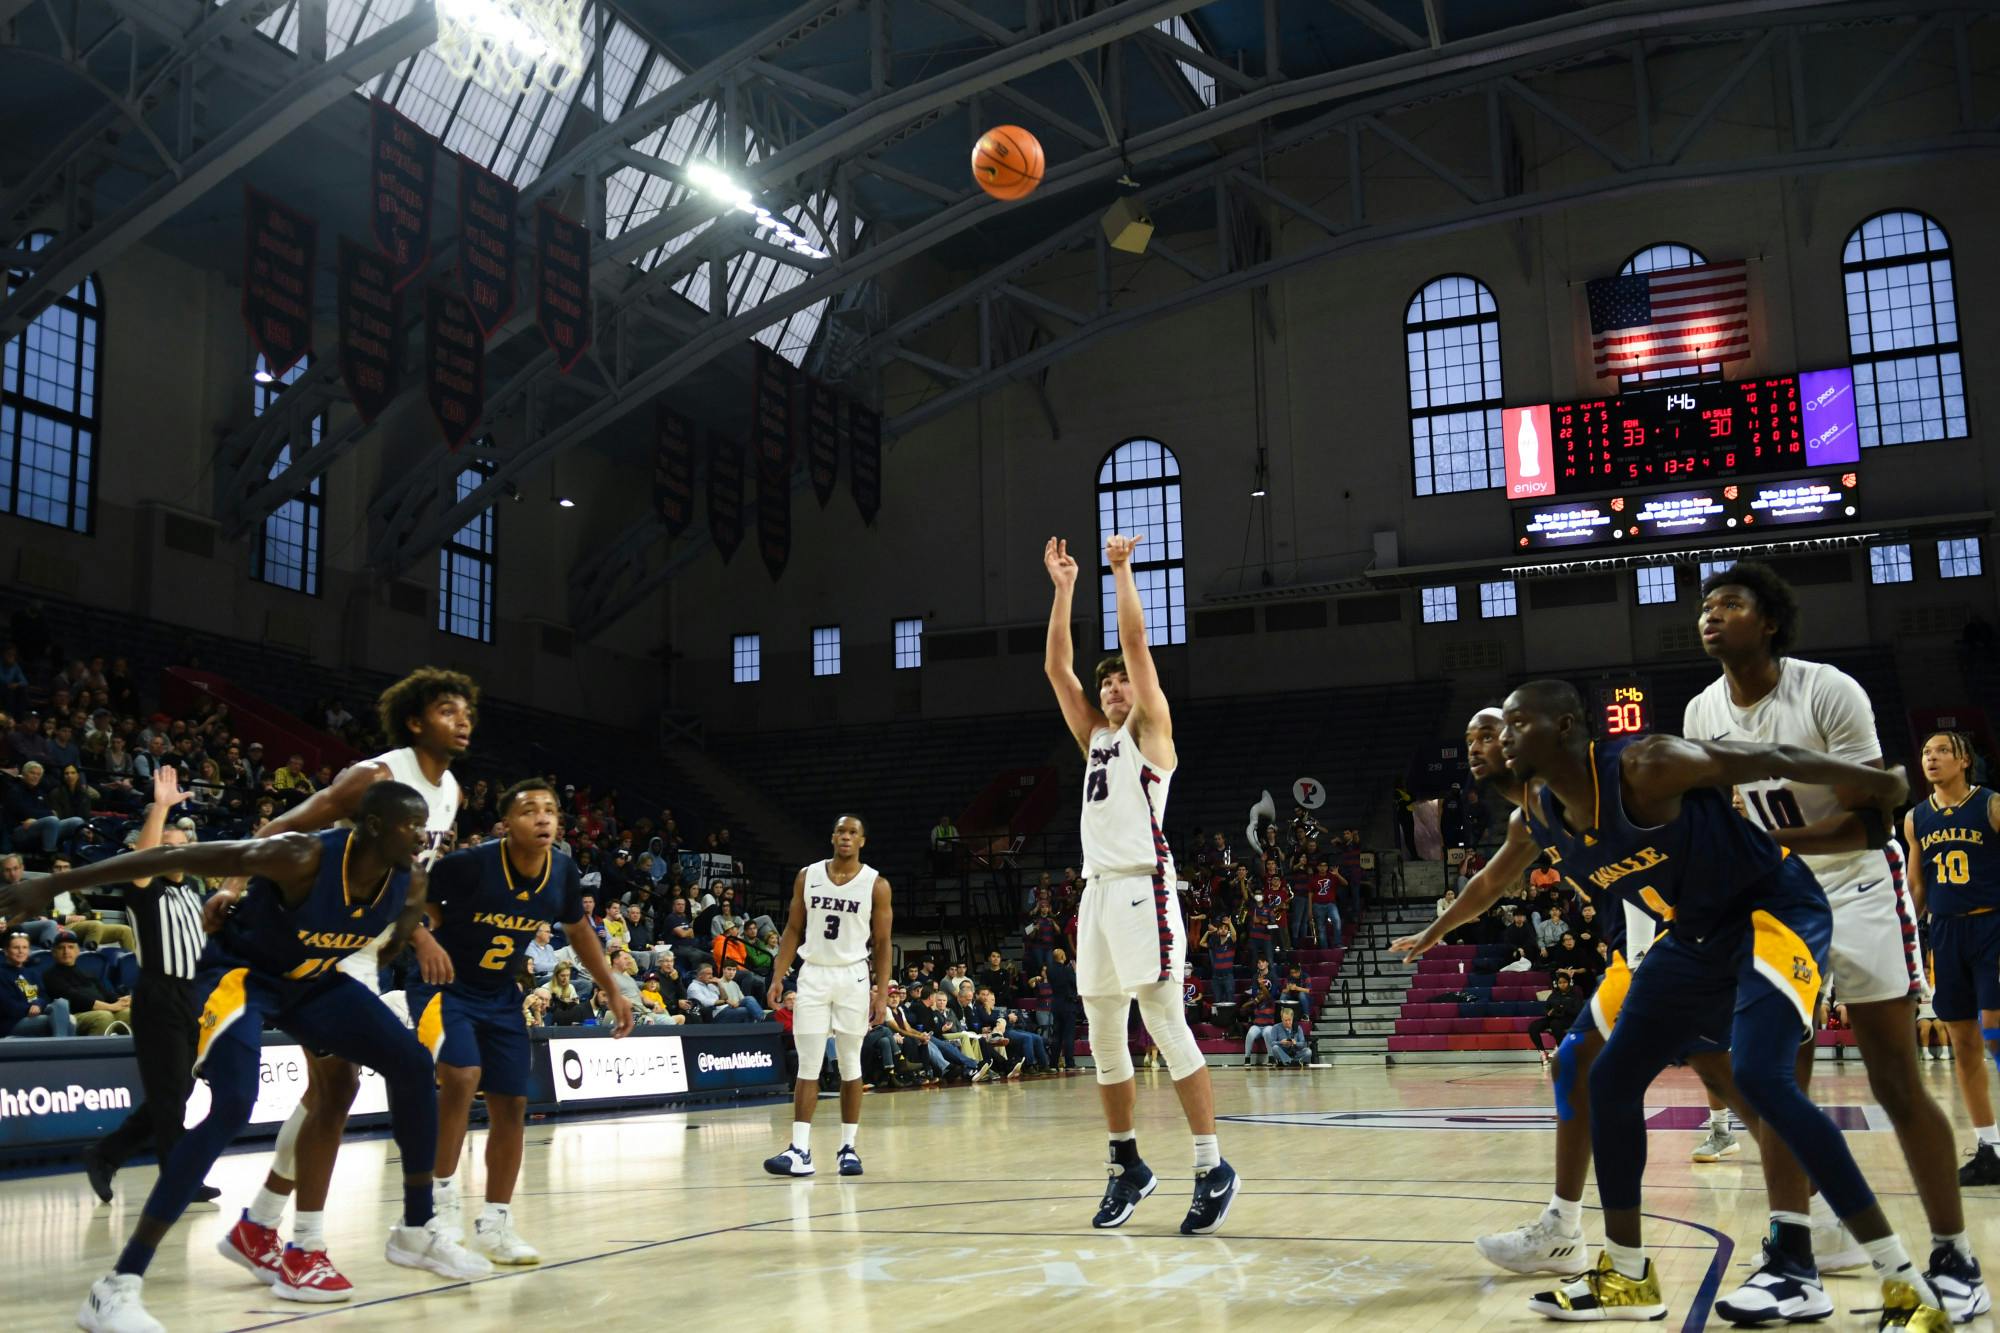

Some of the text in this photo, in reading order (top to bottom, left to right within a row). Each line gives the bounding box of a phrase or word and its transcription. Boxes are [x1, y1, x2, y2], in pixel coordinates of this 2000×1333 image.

[1667, 392, 1696, 411] 1:46
[1746, 393, 1757, 403] 10
[1788, 388, 1794, 398] 2
[1816, 386, 1835, 405] peco
[1713, 407, 1733, 418] SALLE
[1751, 401, 1796, 416] 4 0 0
[1562, 415, 1572, 425] 13
[1584, 412, 1591, 423] 2
[1710, 418, 1731, 438] 30
[1772, 417, 1779, 428] 2
[1790, 415, 1798, 424] 4
[1560, 428, 1573, 438] 22
[1602, 423, 1608, 434] 2
[1623, 427, 1645, 448] 33
[1753, 433, 1760, 443] 2
[1773, 431, 1780, 441] 0
[1820, 424, 1839, 442] peco
[1568, 441, 1573, 451] 3
[1755, 446, 1761, 457] 3
[1789, 442, 1800, 453] 10
[1568, 454, 1575, 463] 4
[1645, 464, 1653, 474] 4
[1702, 458, 1709, 467] 4
[1726, 453, 1735, 468] 8
[1565, 467, 1576, 477] 14
[1604, 463, 1611, 473] 0
[1514, 481, 1548, 494] enjoy
[1614, 687, 1643, 702] 1:46
[1607, 703, 1641, 733] 30
[1300, 783, 1318, 805] P
[1747, 787, 1807, 832] 10
[1921, 827, 1984, 851] LASALLE
[1932, 849, 1970, 885] 10
[811, 895, 861, 914] PENN
[824, 914, 841, 940] 3
[479, 935, 514, 971] 2
[698, 1051, 773, 1072] @PennAthletics
[0, 1085, 131, 1120] htOnPenn
